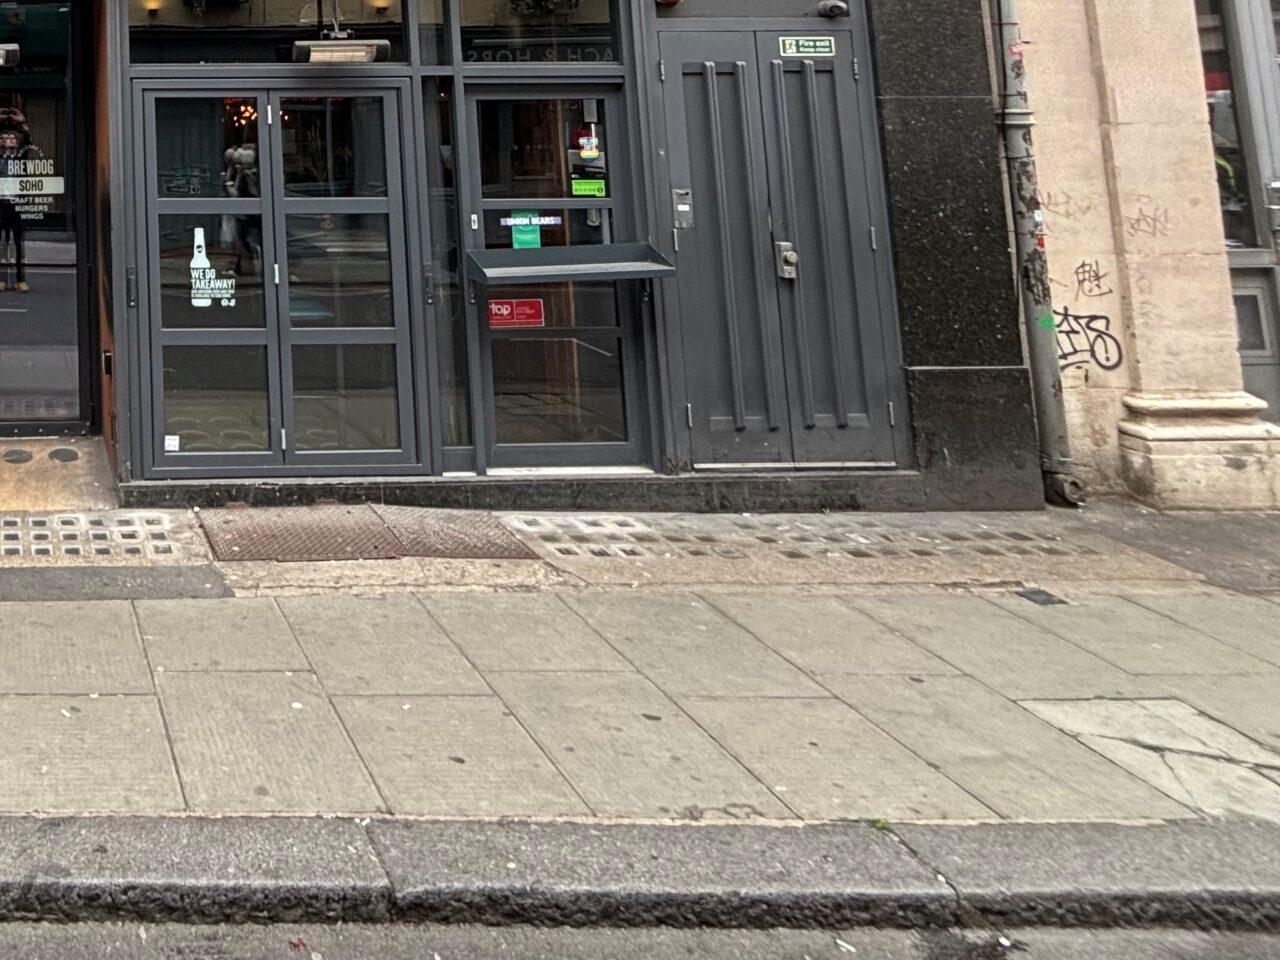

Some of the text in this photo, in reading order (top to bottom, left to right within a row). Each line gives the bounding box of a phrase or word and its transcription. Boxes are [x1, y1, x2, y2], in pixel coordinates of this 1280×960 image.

[8, 159, 54, 175] BREWDOG
[19, 180, 43, 192] SOHO
[190, 268, 216, 279] WE DO
[191, 279, 236, 290] TAKEAWAY!
